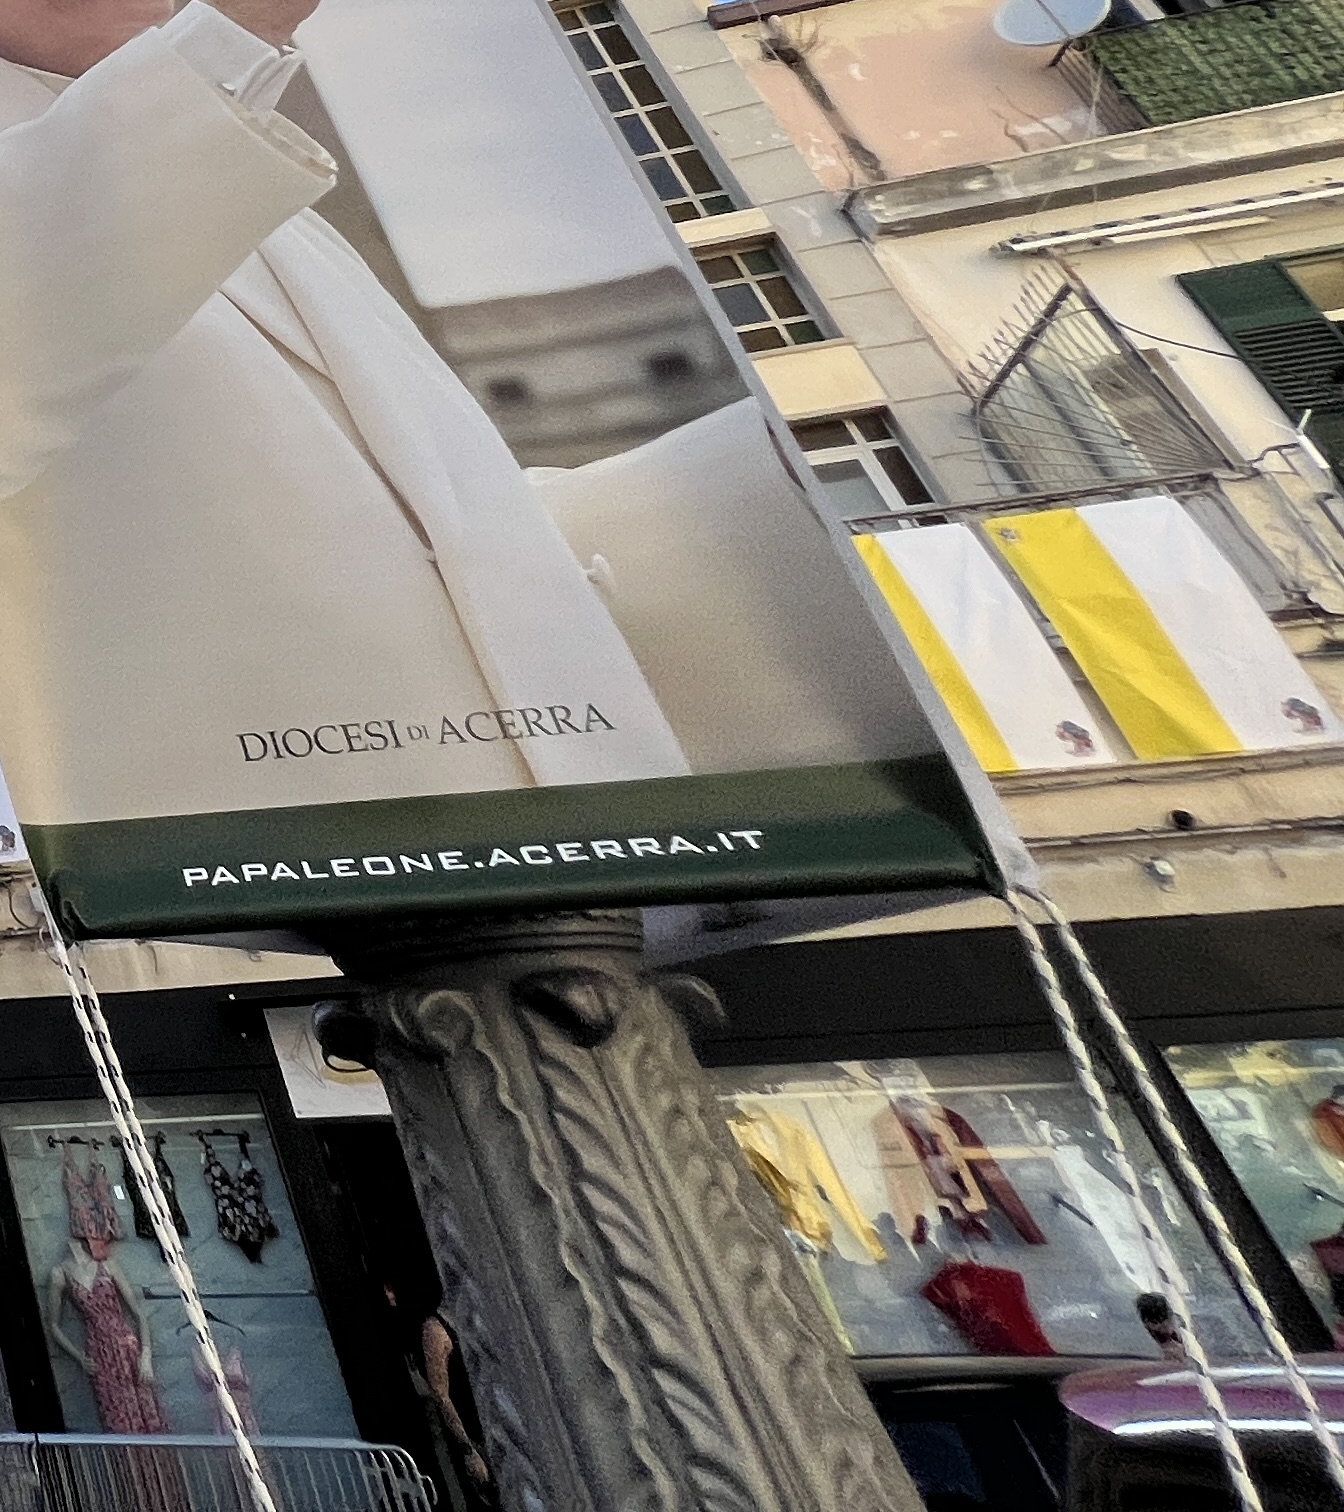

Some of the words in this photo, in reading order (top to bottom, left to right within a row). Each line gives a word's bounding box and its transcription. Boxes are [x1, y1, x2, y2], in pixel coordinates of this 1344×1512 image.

[236, 719, 405, 762] DIOCESI
[408, 725, 430, 741] DI
[438, 702, 616, 745] ACERRA
[182, 829, 765, 888] PAPALEONE.ACERRA.IT
